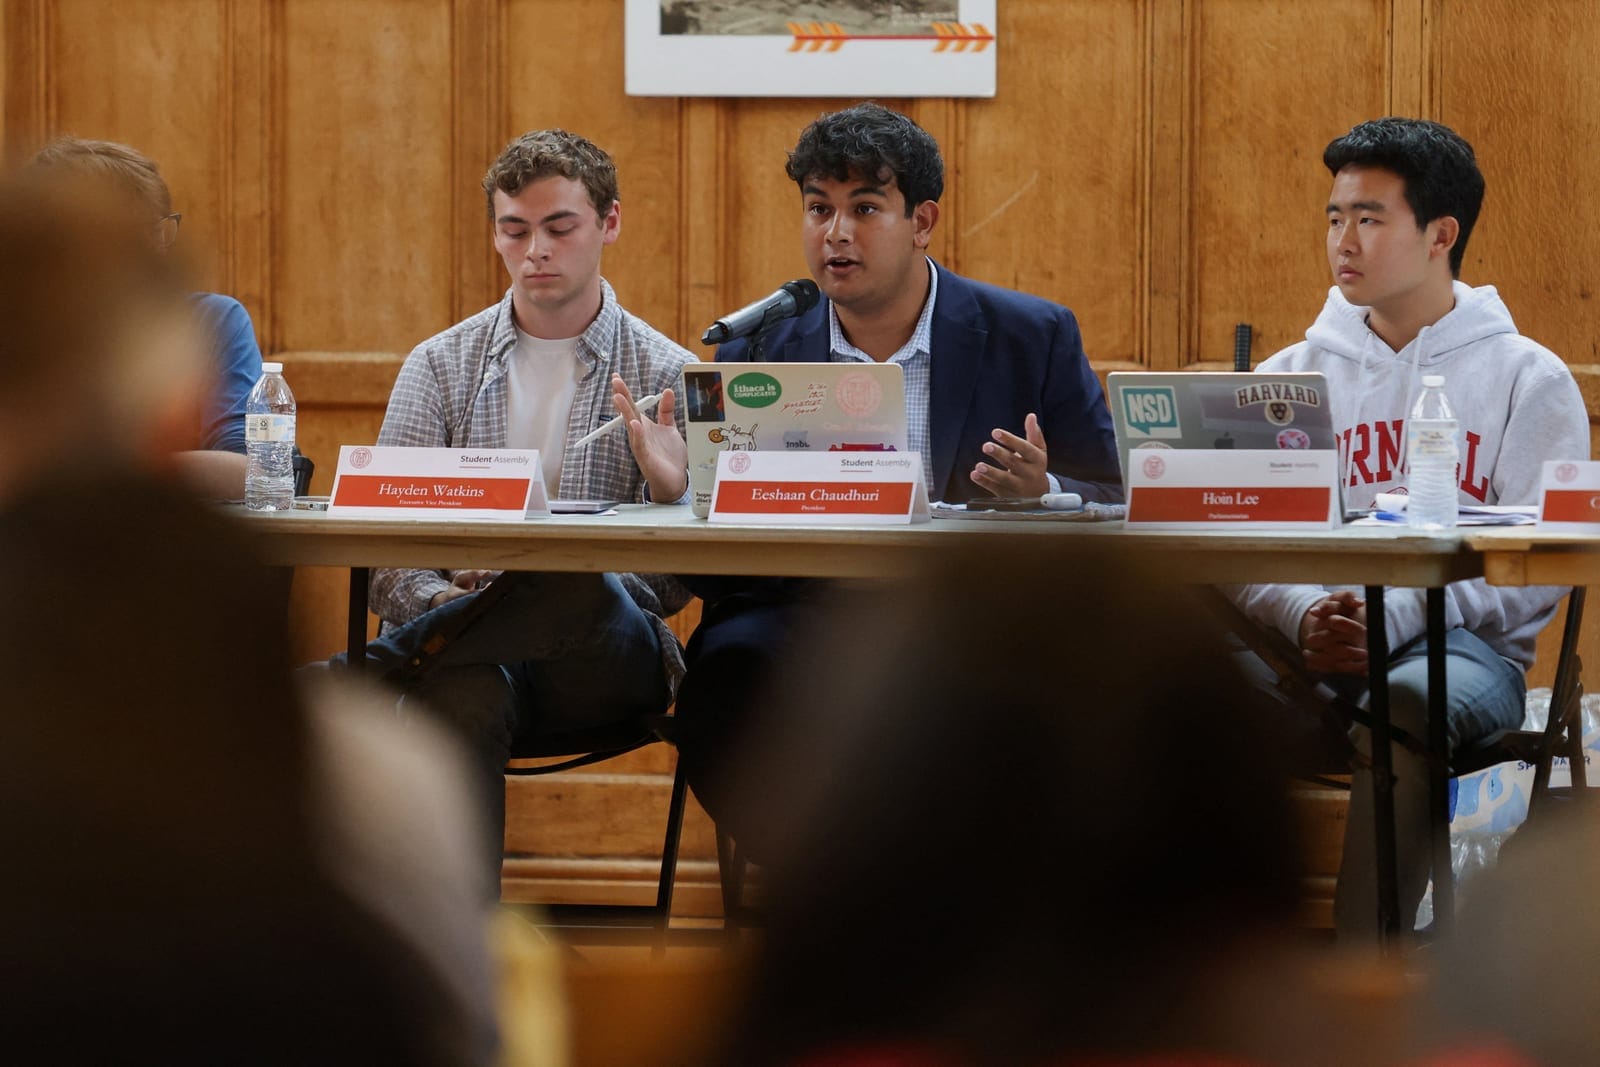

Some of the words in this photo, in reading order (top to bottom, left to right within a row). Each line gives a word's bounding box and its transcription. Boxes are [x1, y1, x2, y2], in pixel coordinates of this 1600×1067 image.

[734, 383, 765, 393] Ithaca
[767, 383, 776, 391] is
[1238, 384, 1318, 406] HARVARD
[1127, 393, 1173, 424] NSD
[460, 455, 492, 463] Student
[493, 455, 529, 465] Assembly
[841, 459, 873, 467] Student
[875, 459, 912, 468] Assembly
[378, 483, 428, 498] Hayden
[432, 484, 485, 497] Watkins
[751, 488, 806, 501] Eeshaan
[810, 488, 880, 502] Chaudhuri
[1203, 492, 1234, 505] Hoin
[1236, 492, 1260, 505] Lee
